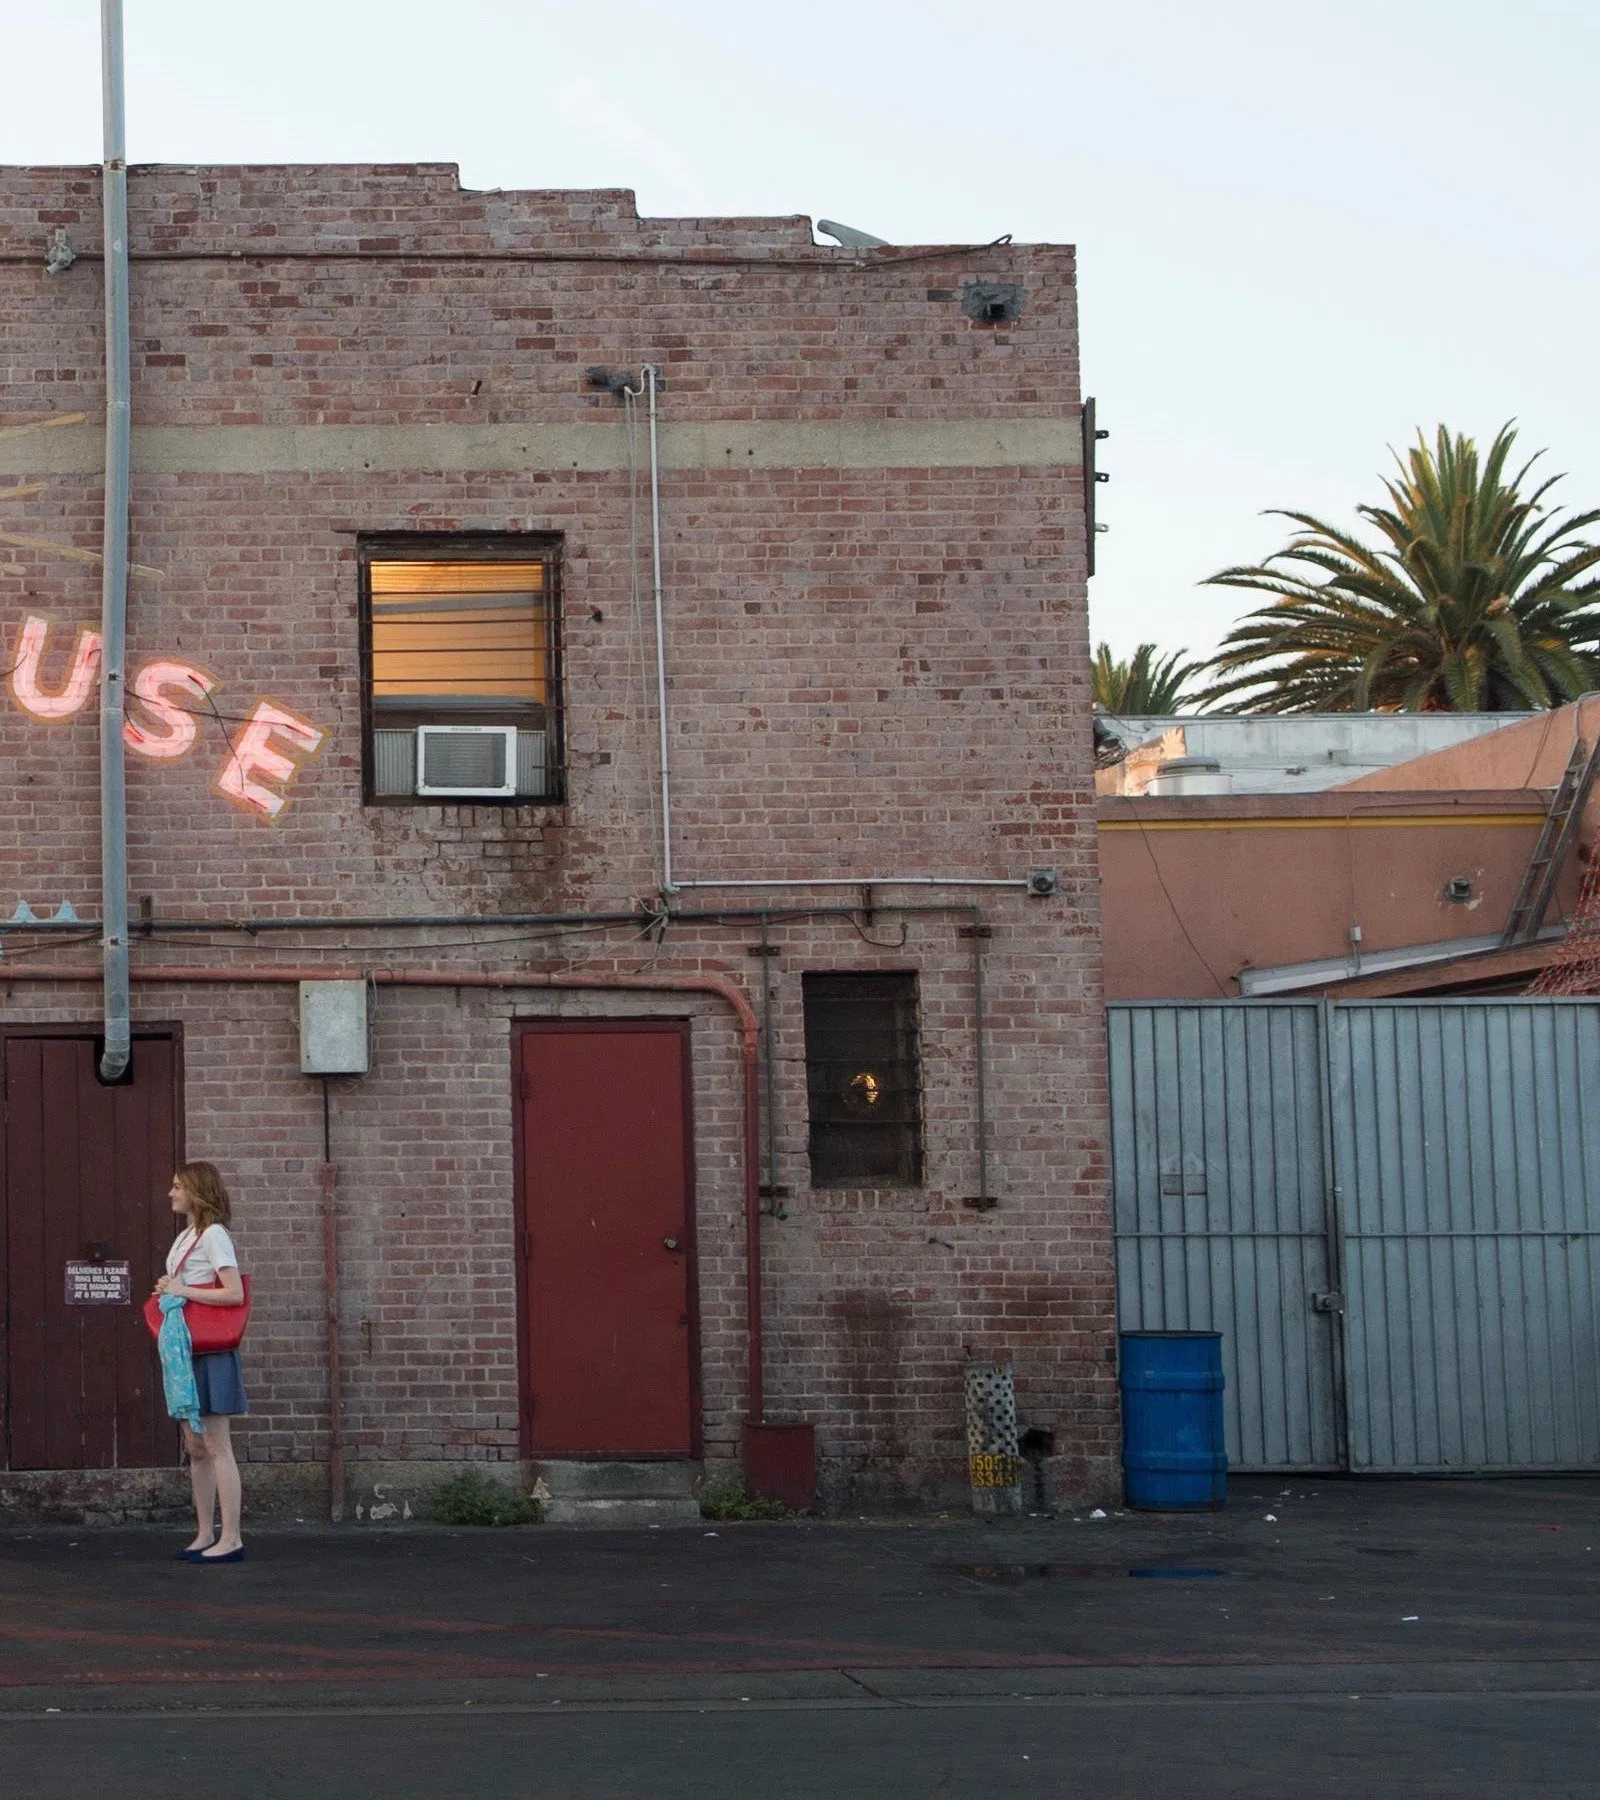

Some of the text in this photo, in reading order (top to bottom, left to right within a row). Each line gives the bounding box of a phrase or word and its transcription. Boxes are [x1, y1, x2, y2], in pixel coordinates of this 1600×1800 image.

[103, 1266, 129, 1275] PLEASE
[92, 1275, 109, 1283] BELL
[110, 1275, 121, 1283] OR
